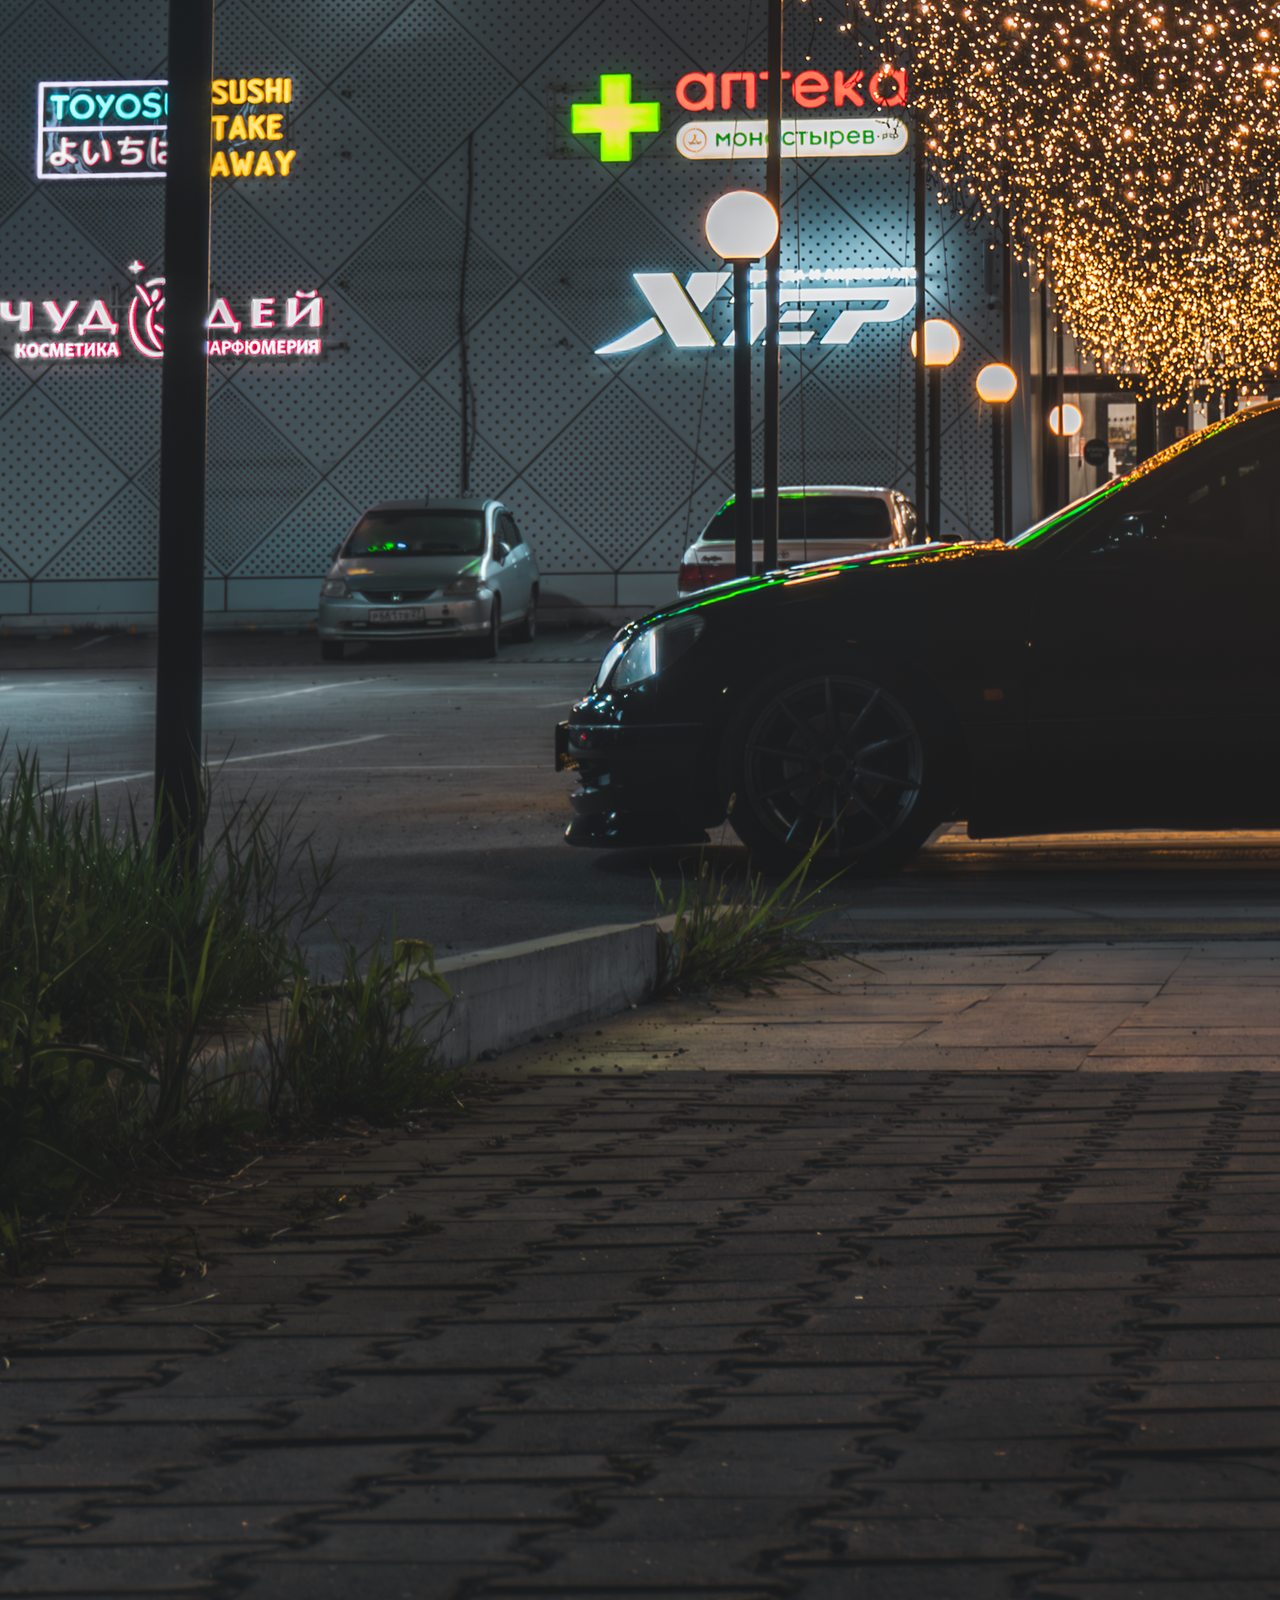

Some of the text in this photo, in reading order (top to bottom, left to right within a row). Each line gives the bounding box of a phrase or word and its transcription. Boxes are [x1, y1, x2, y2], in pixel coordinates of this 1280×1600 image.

[211, 77, 292, 105] SUSHI
[50, 92, 168, 120] TOYOS
[211, 113, 284, 141] TAKE
[715, 128, 899, 149] монстырев.рф
[210, 149, 296, 178] AWAY
[14, 341, 121, 359] КОСМЕТИКА
[206, 338, 322, 356] АРФЮМЕРИЯ
